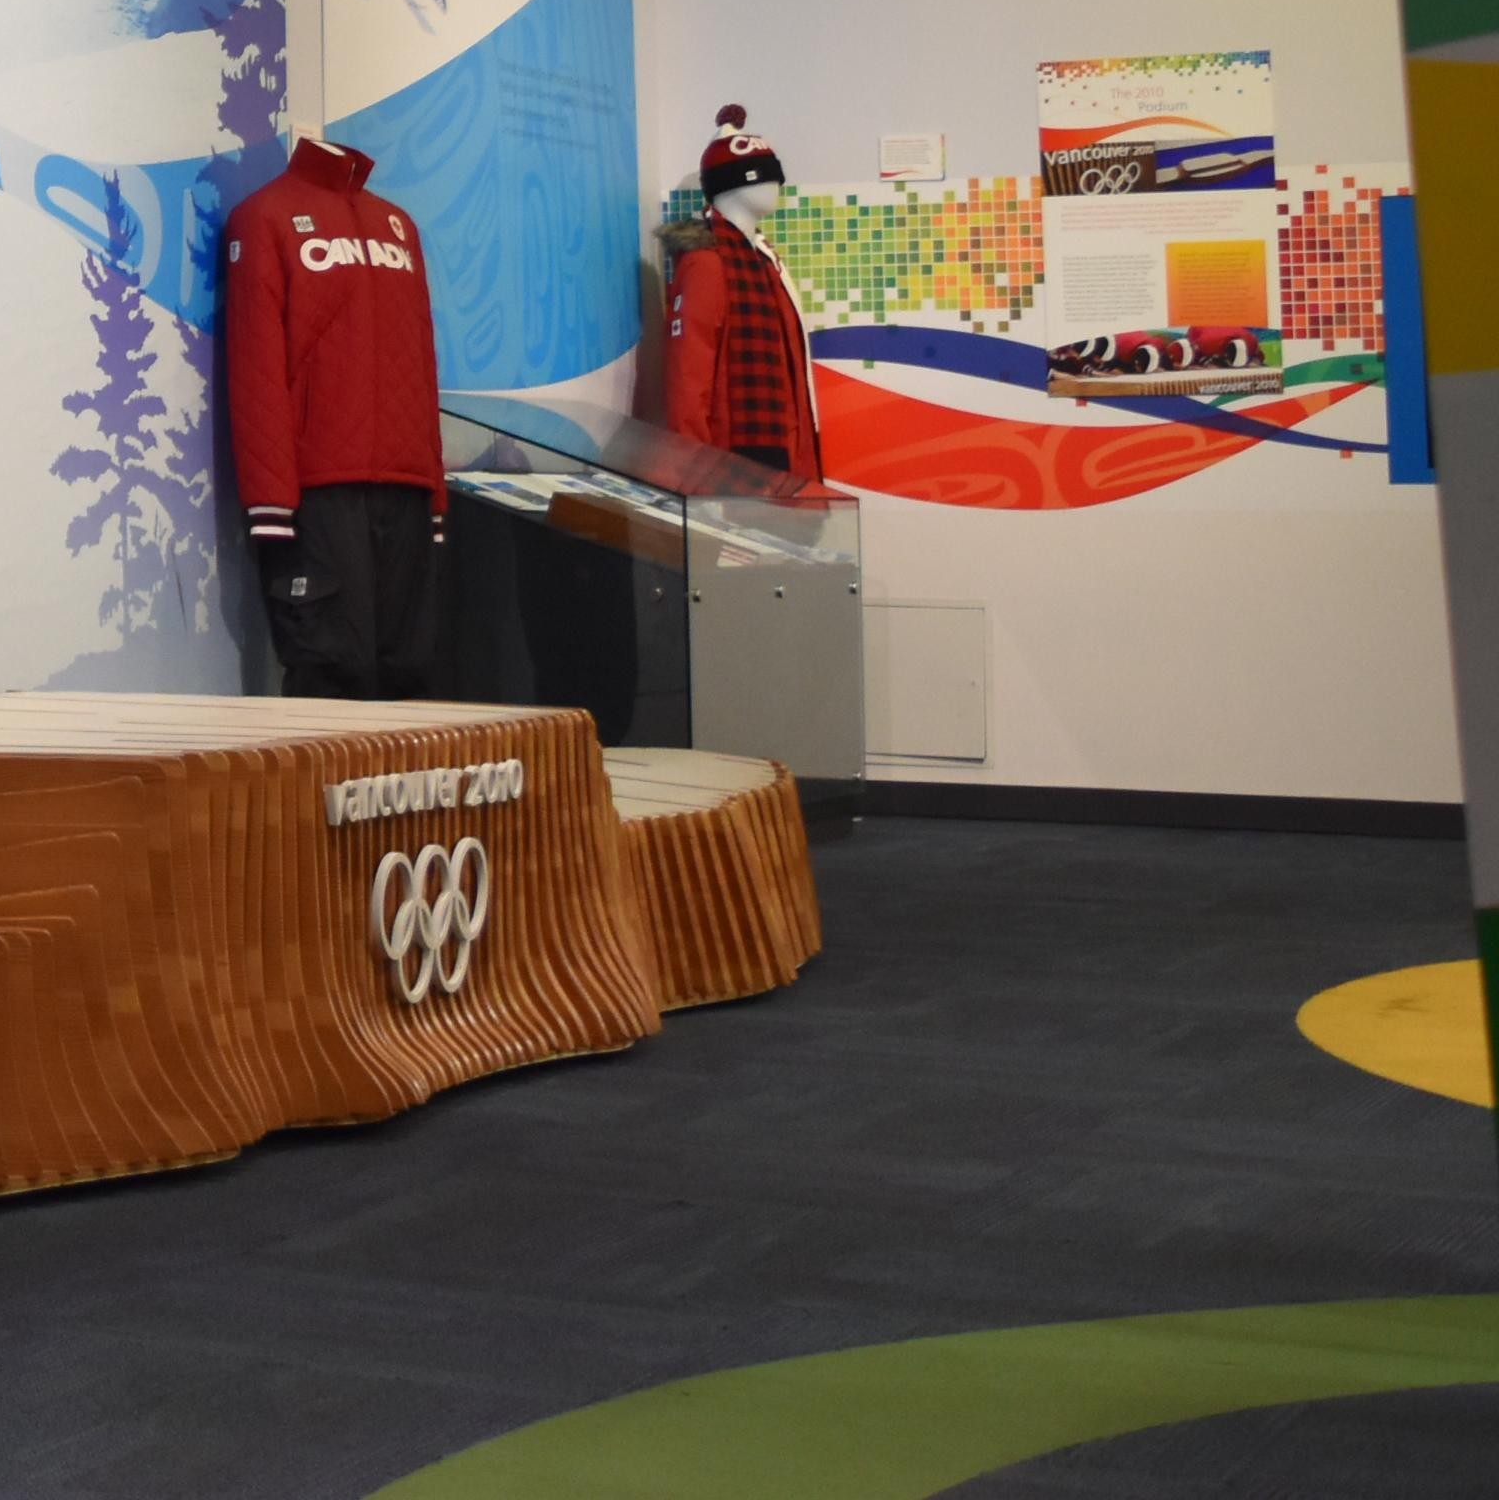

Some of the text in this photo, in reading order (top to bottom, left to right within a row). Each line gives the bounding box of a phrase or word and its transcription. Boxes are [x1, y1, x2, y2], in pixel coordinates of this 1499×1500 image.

[1110, 86, 1164, 100] The 2010
[1138, 101, 1188, 113] Podium
[1044, 143, 1132, 166] vancouver
[462, 758, 524, 807] 2010
